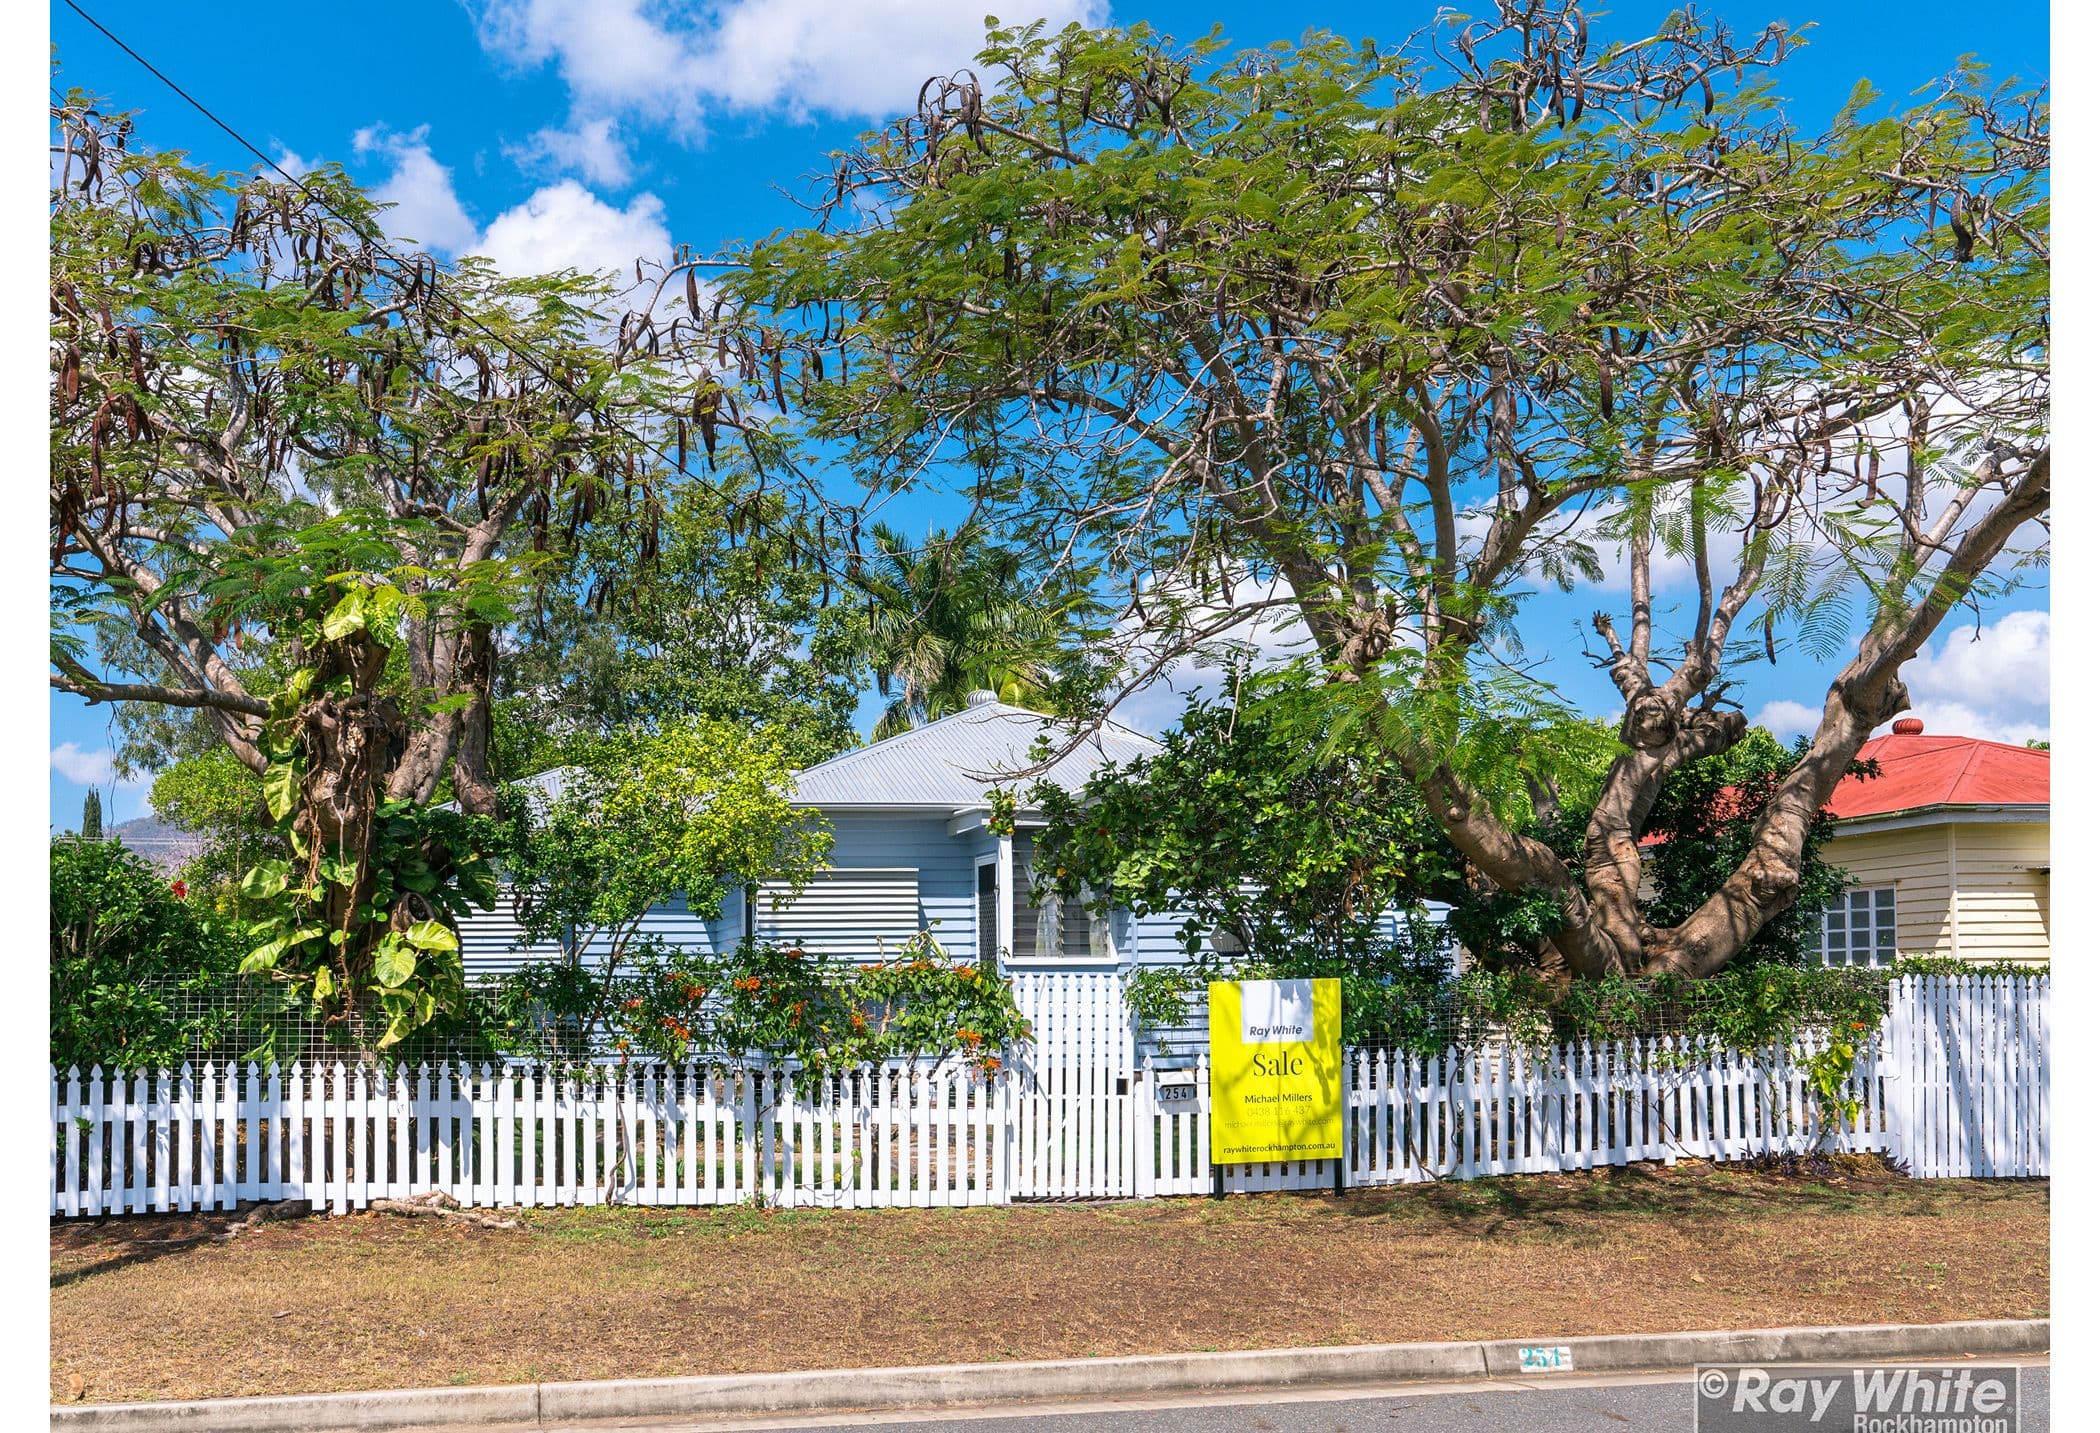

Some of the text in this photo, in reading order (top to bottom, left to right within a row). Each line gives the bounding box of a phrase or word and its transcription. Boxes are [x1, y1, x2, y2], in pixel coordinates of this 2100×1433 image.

[1249, 1024, 1303, 1038] Ray White
[1252, 1050, 1304, 1077] Sale
[1165, 1087, 1187, 1100] 254
[1244, 1092, 1313, 1104] Michael Millers
[1223, 1142, 1336, 1155] raywhiterockhampton.com.au
